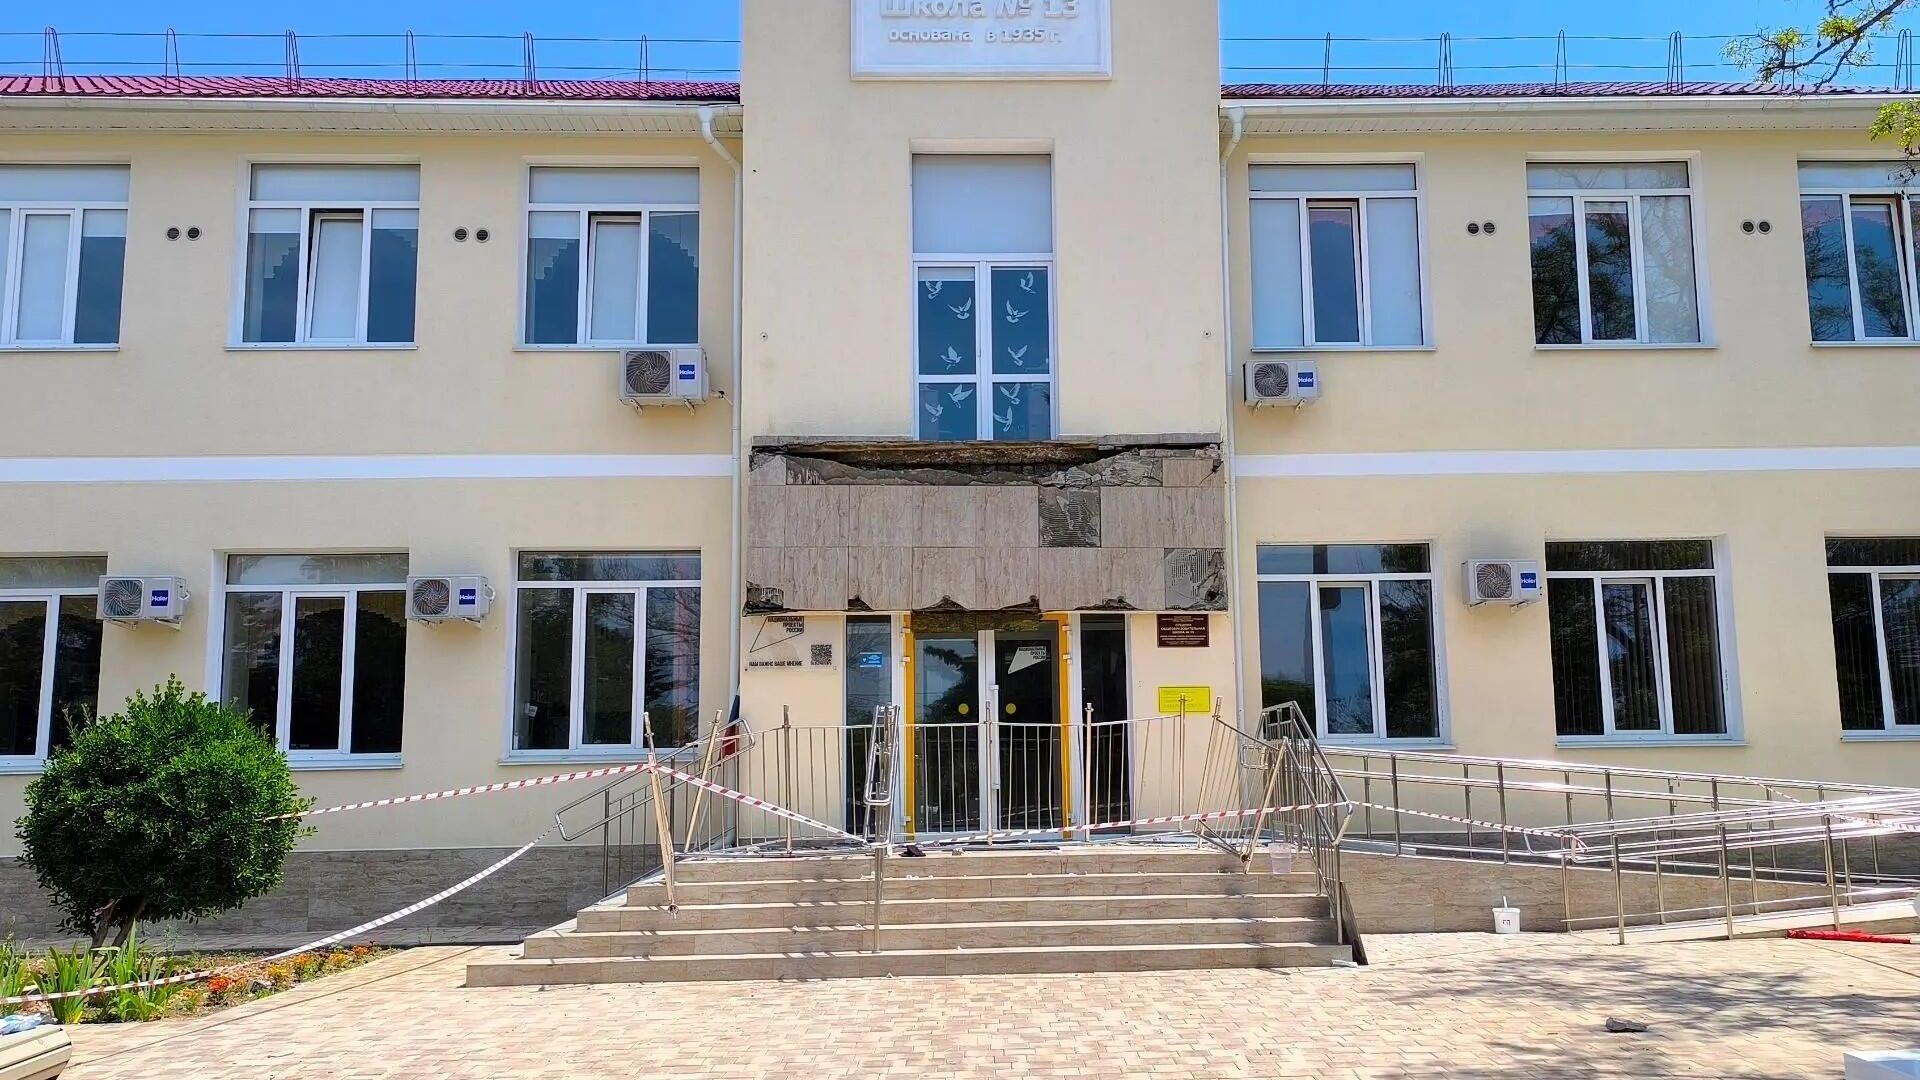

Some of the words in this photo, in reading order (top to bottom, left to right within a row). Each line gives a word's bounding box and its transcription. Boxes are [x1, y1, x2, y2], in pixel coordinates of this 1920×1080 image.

[1043, 0, 1080, 18] 13
[888, 29, 974, 42] основана
[985, 30, 997, 42] в
[1001, 27, 1046, 43] 1935
